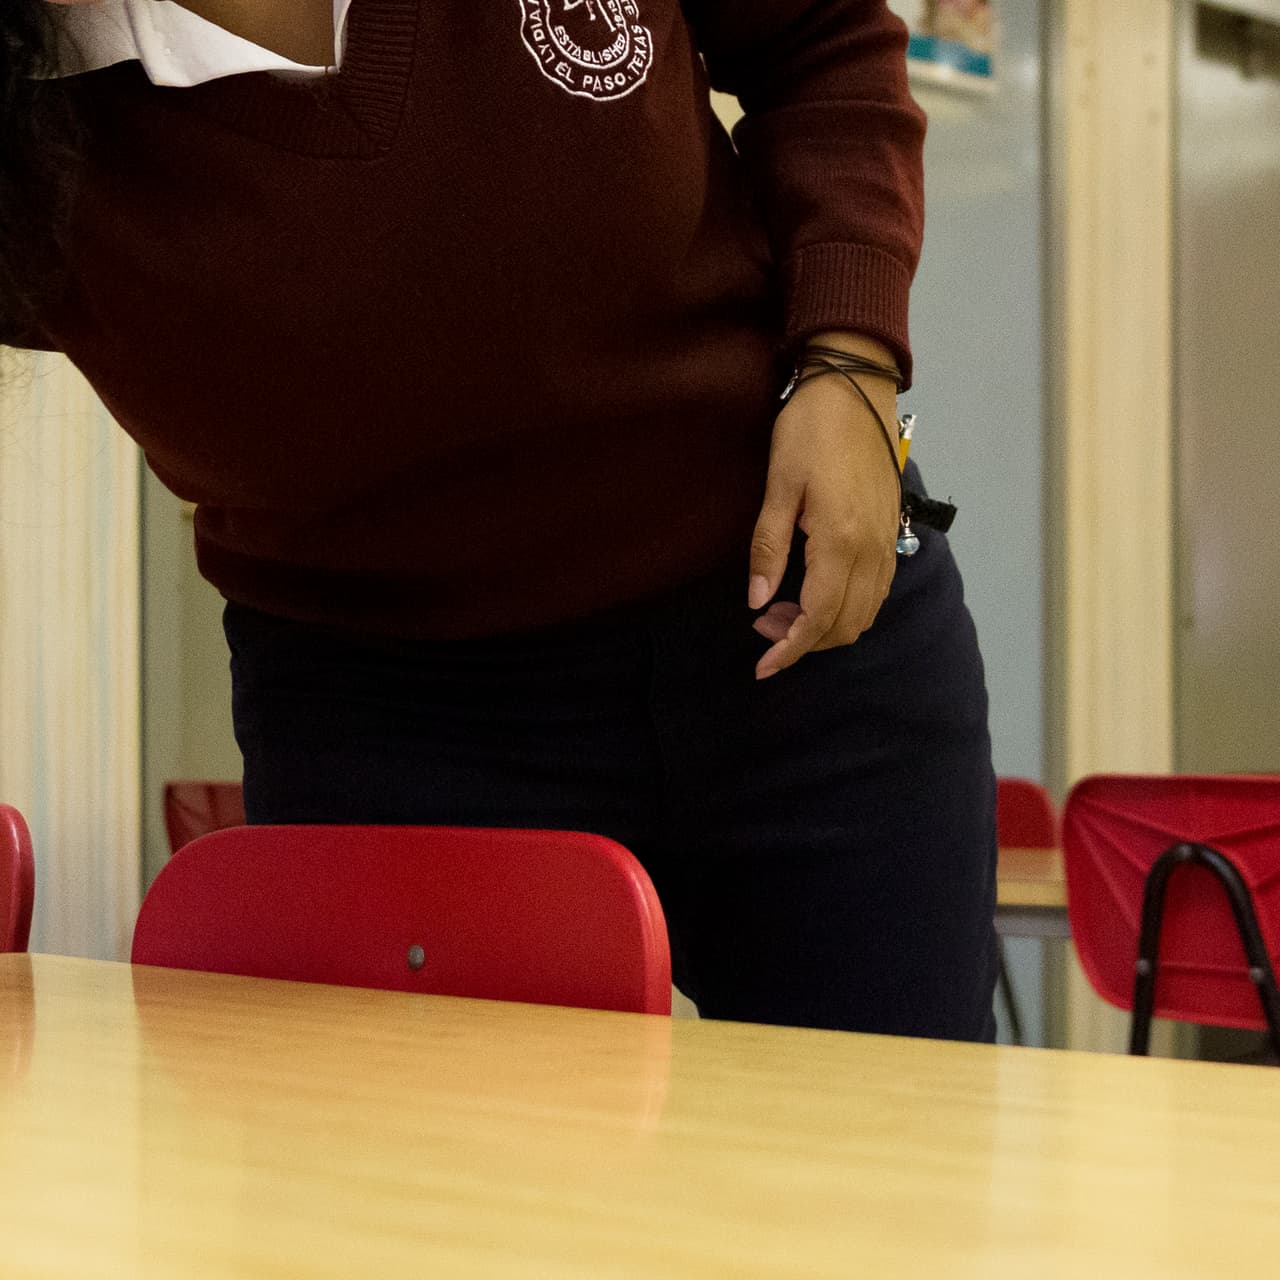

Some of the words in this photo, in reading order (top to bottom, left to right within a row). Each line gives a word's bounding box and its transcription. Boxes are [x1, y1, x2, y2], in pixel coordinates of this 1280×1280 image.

[529, 8, 555, 63] LYDIA
[554, 25, 626, 64] ESTABLISHED
[555, 62, 575, 84] EL
[627, 25, 647, 75] TEXAS
